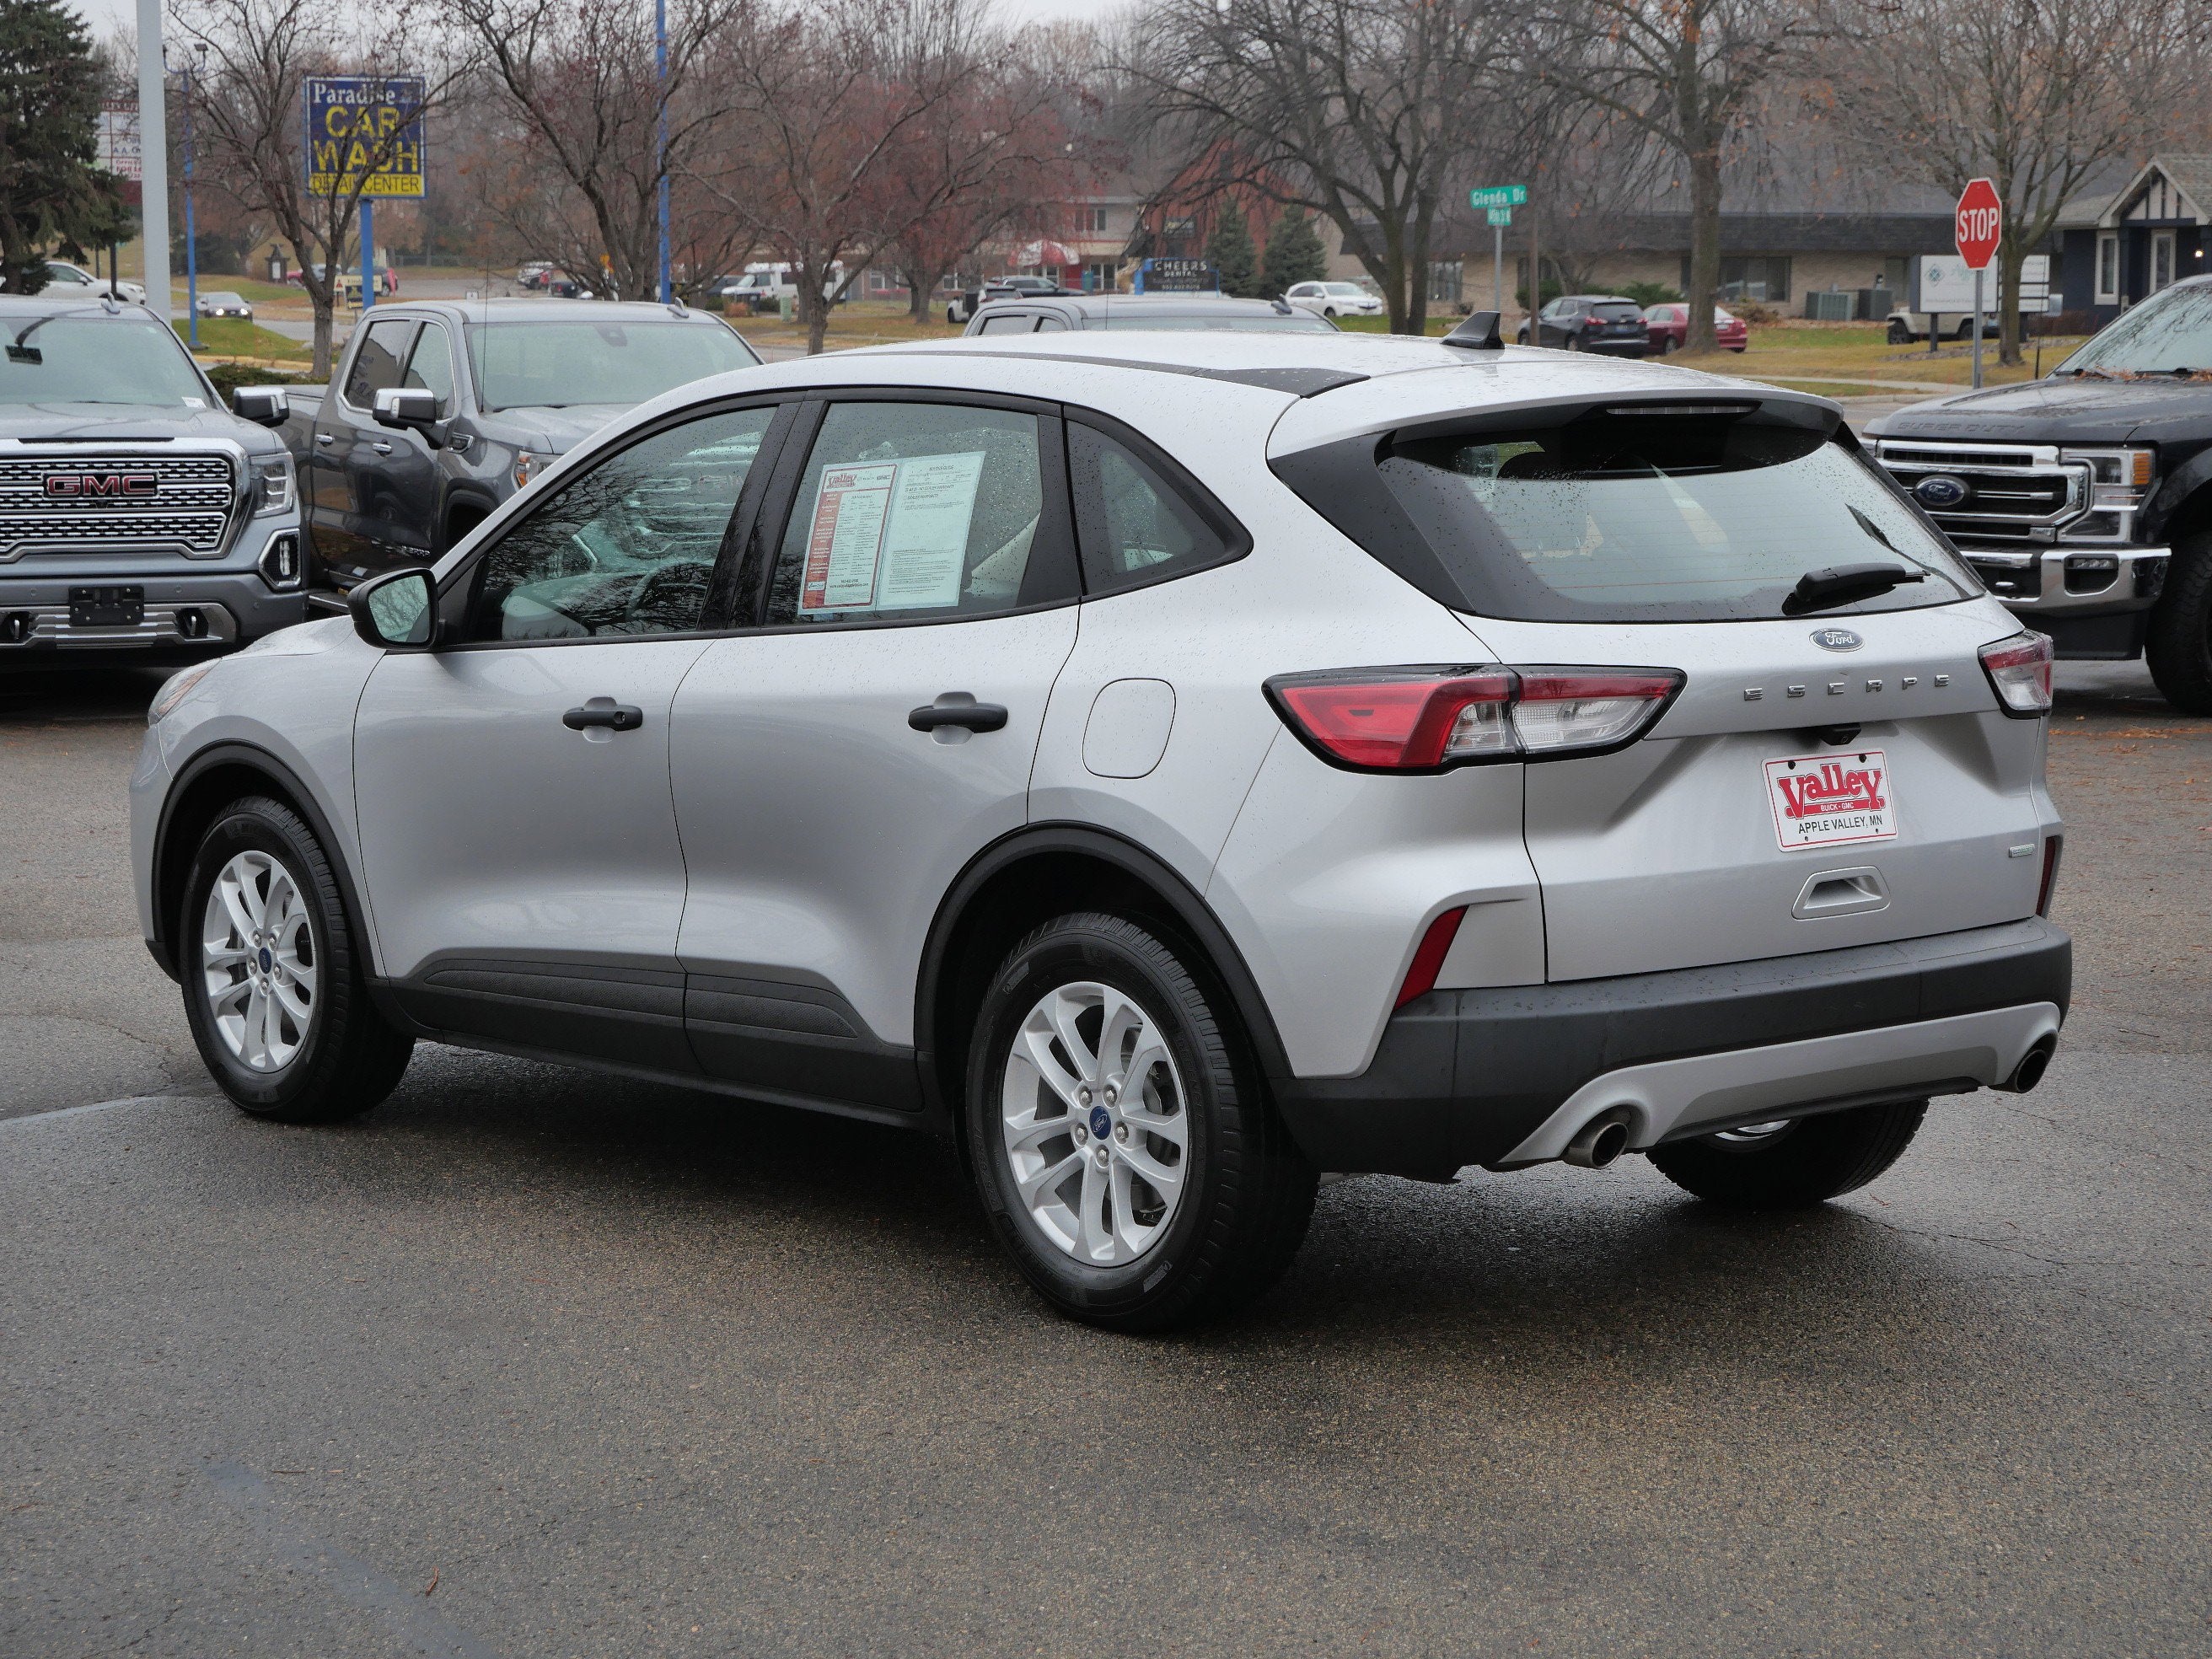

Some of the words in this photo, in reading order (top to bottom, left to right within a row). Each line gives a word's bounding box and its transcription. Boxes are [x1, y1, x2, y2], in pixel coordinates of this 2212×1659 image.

[325, 105, 400, 137] CAR
[1472, 190, 1508, 207] Glenda
[1512, 187, 1525, 202] Dr
[1958, 207, 2000, 243] STOP
[1154, 260, 1208, 271] CHEERS
[46, 475, 155, 496] GMC
[1824, 631, 1855, 646] Ford
[1743, 674, 1950, 701] ESCAPE
[1820, 802, 1839, 812] BUICK
[1841, 802, 1855, 810] GMC
[1798, 818, 1830, 834] APPLE
[1831, 815, 1868, 830] VALLEY,
[1869, 814, 1883, 826] MN
